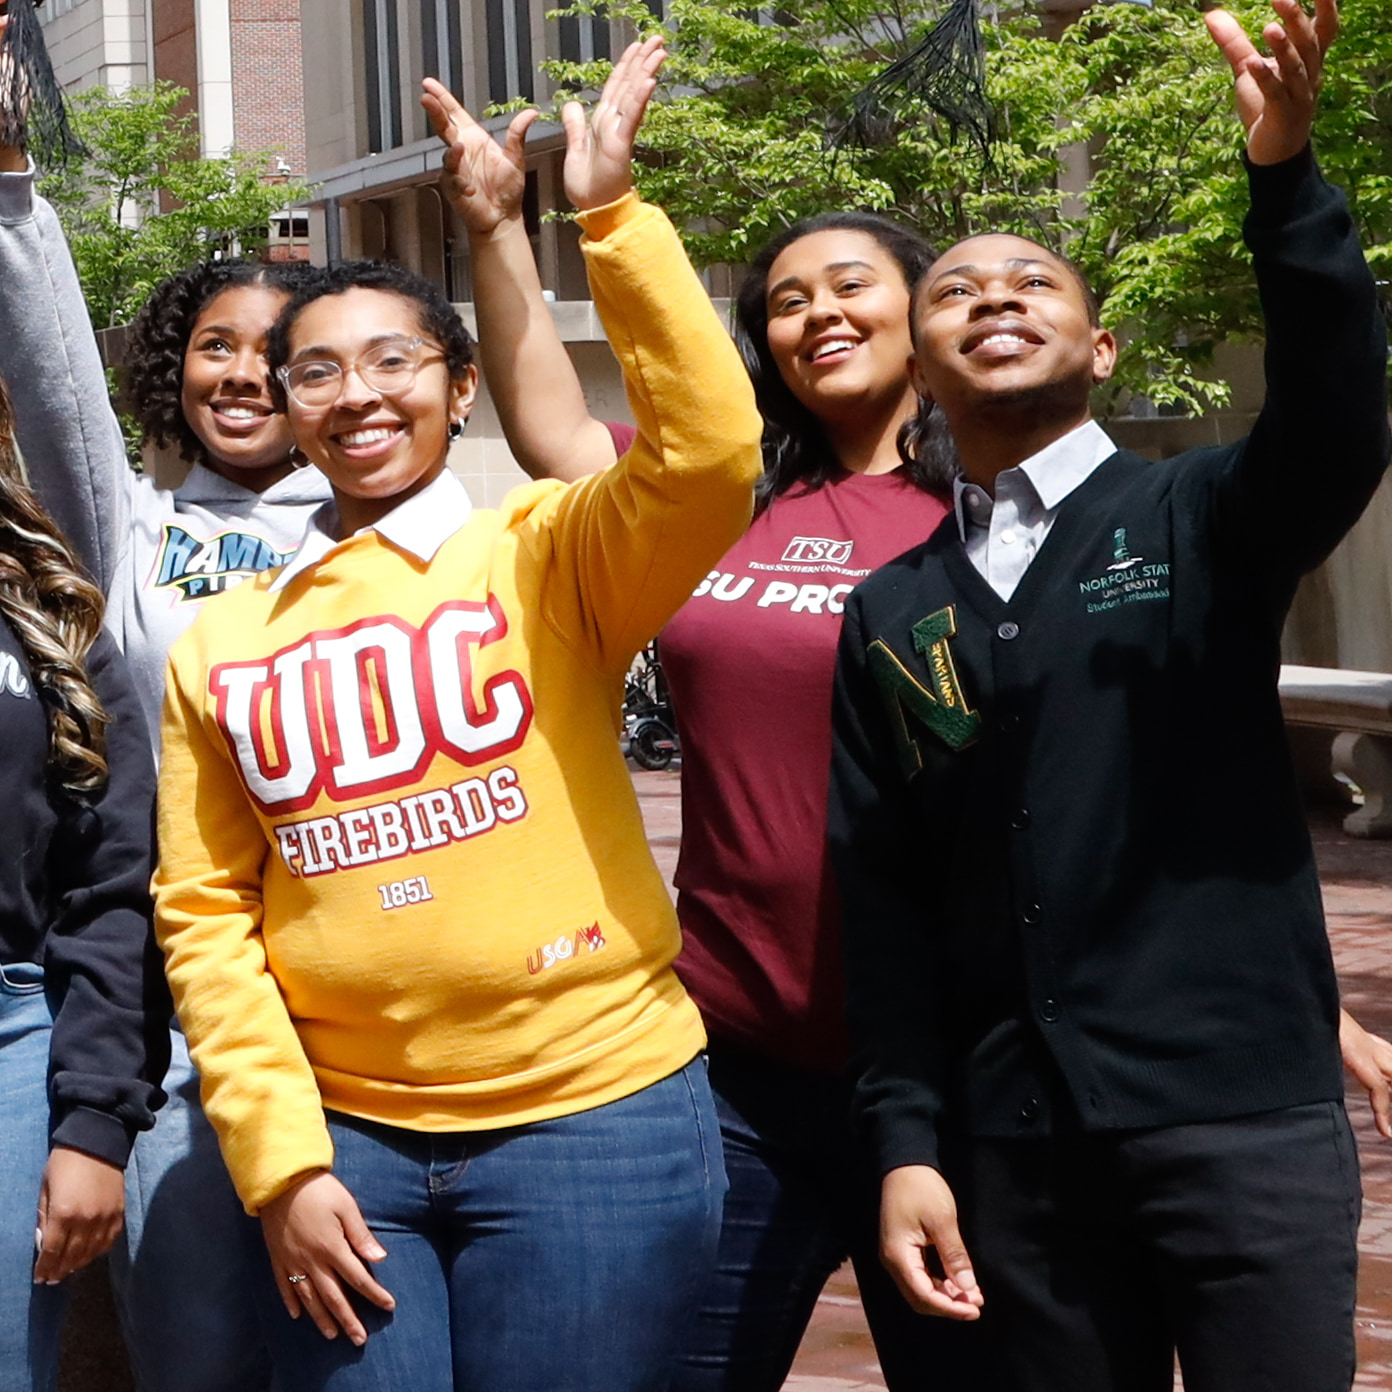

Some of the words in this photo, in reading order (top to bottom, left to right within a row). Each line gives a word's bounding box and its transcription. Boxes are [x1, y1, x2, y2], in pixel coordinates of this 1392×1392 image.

[156, 526, 295, 587] HAMP
[791, 539, 851, 562] TSU
[821, 564, 872, 577] UNIVERSITY
[1079, 569, 1140, 594] NORFOLK
[1101, 578, 1159, 599] UNIVERSITY
[209, 592, 534, 817] UDC
[275, 765, 529, 878] FIREBIRDS
[378, 875, 434, 910] 1851
